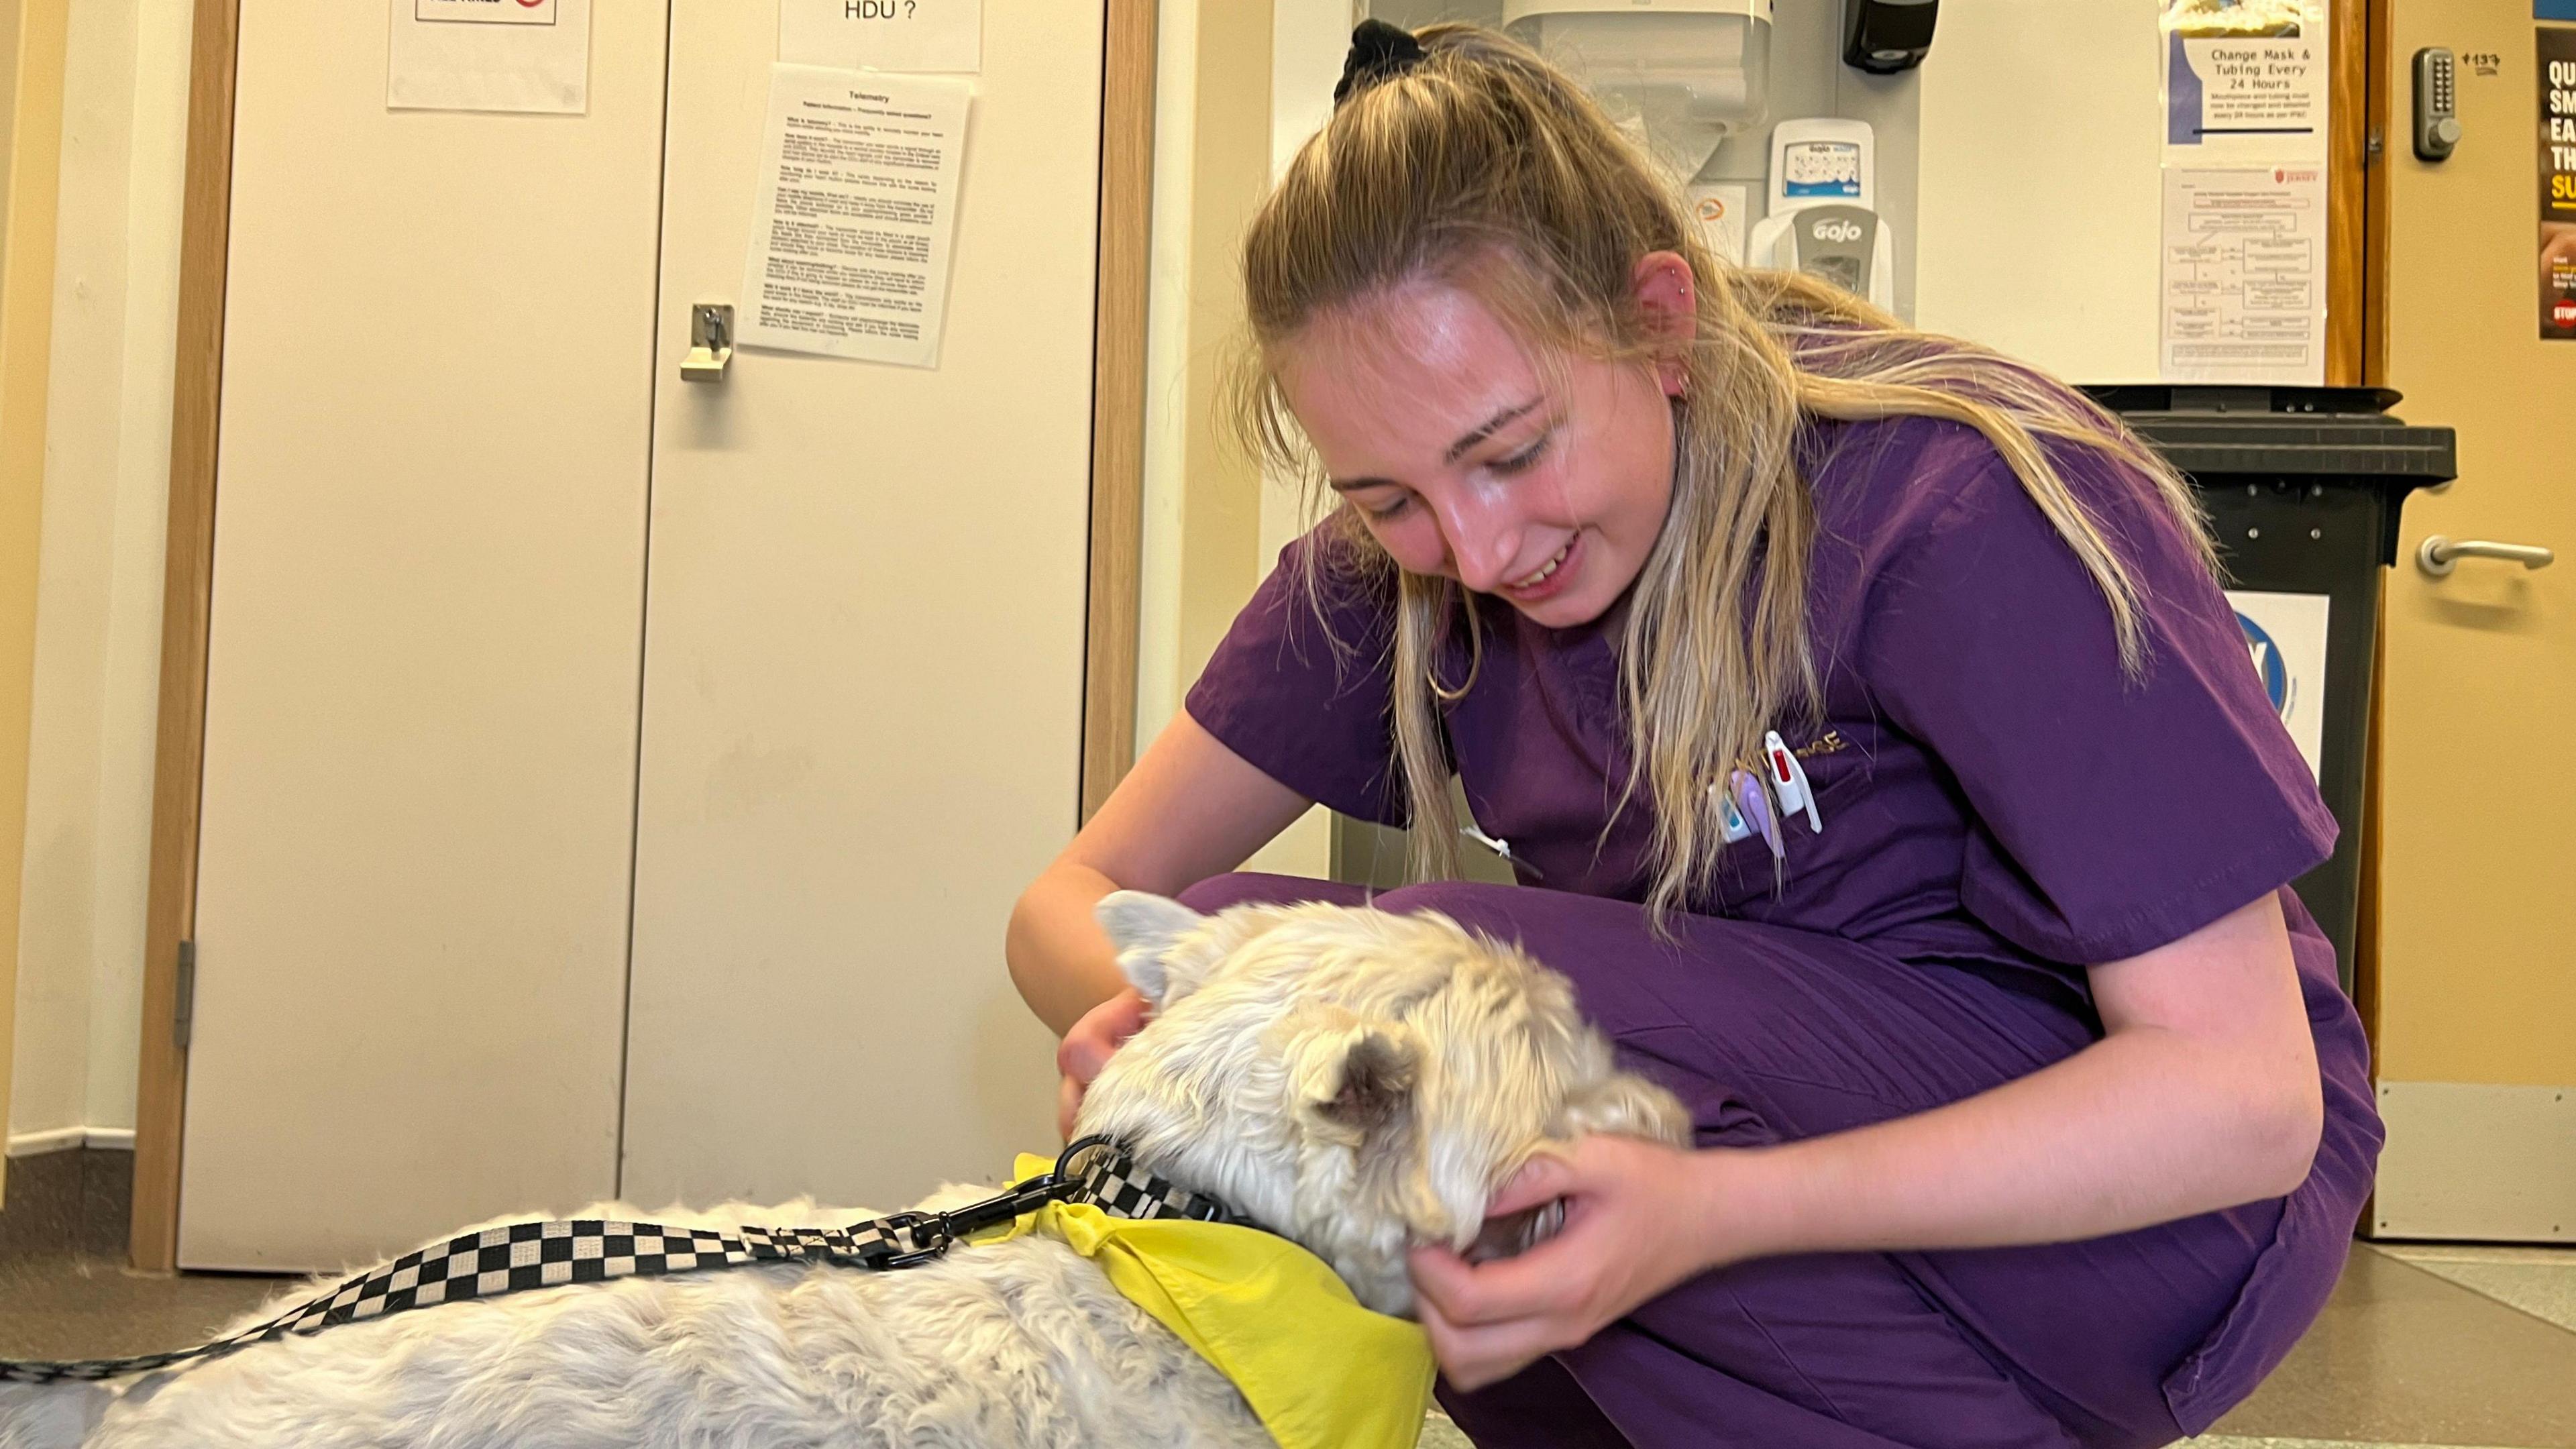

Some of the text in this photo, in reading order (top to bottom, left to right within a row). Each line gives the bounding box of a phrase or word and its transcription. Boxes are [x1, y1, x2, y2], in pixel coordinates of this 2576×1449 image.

[845, 0, 916, 19] HDU ?
[2211, 48, 2311, 62] Change Mask &
[2216, 64, 2306, 77] Tubing Every
[2549, 61, 2576, 89] QU
[2231, 78, 2290, 89] 24 Hours
[849, 91, 889, 104] Telemetry
[2550, 89, 2576, 114] SM
[2551, 117, 2576, 142] EA
[2551, 146, 2576, 171] TH
[2551, 174, 2576, 199] SU
